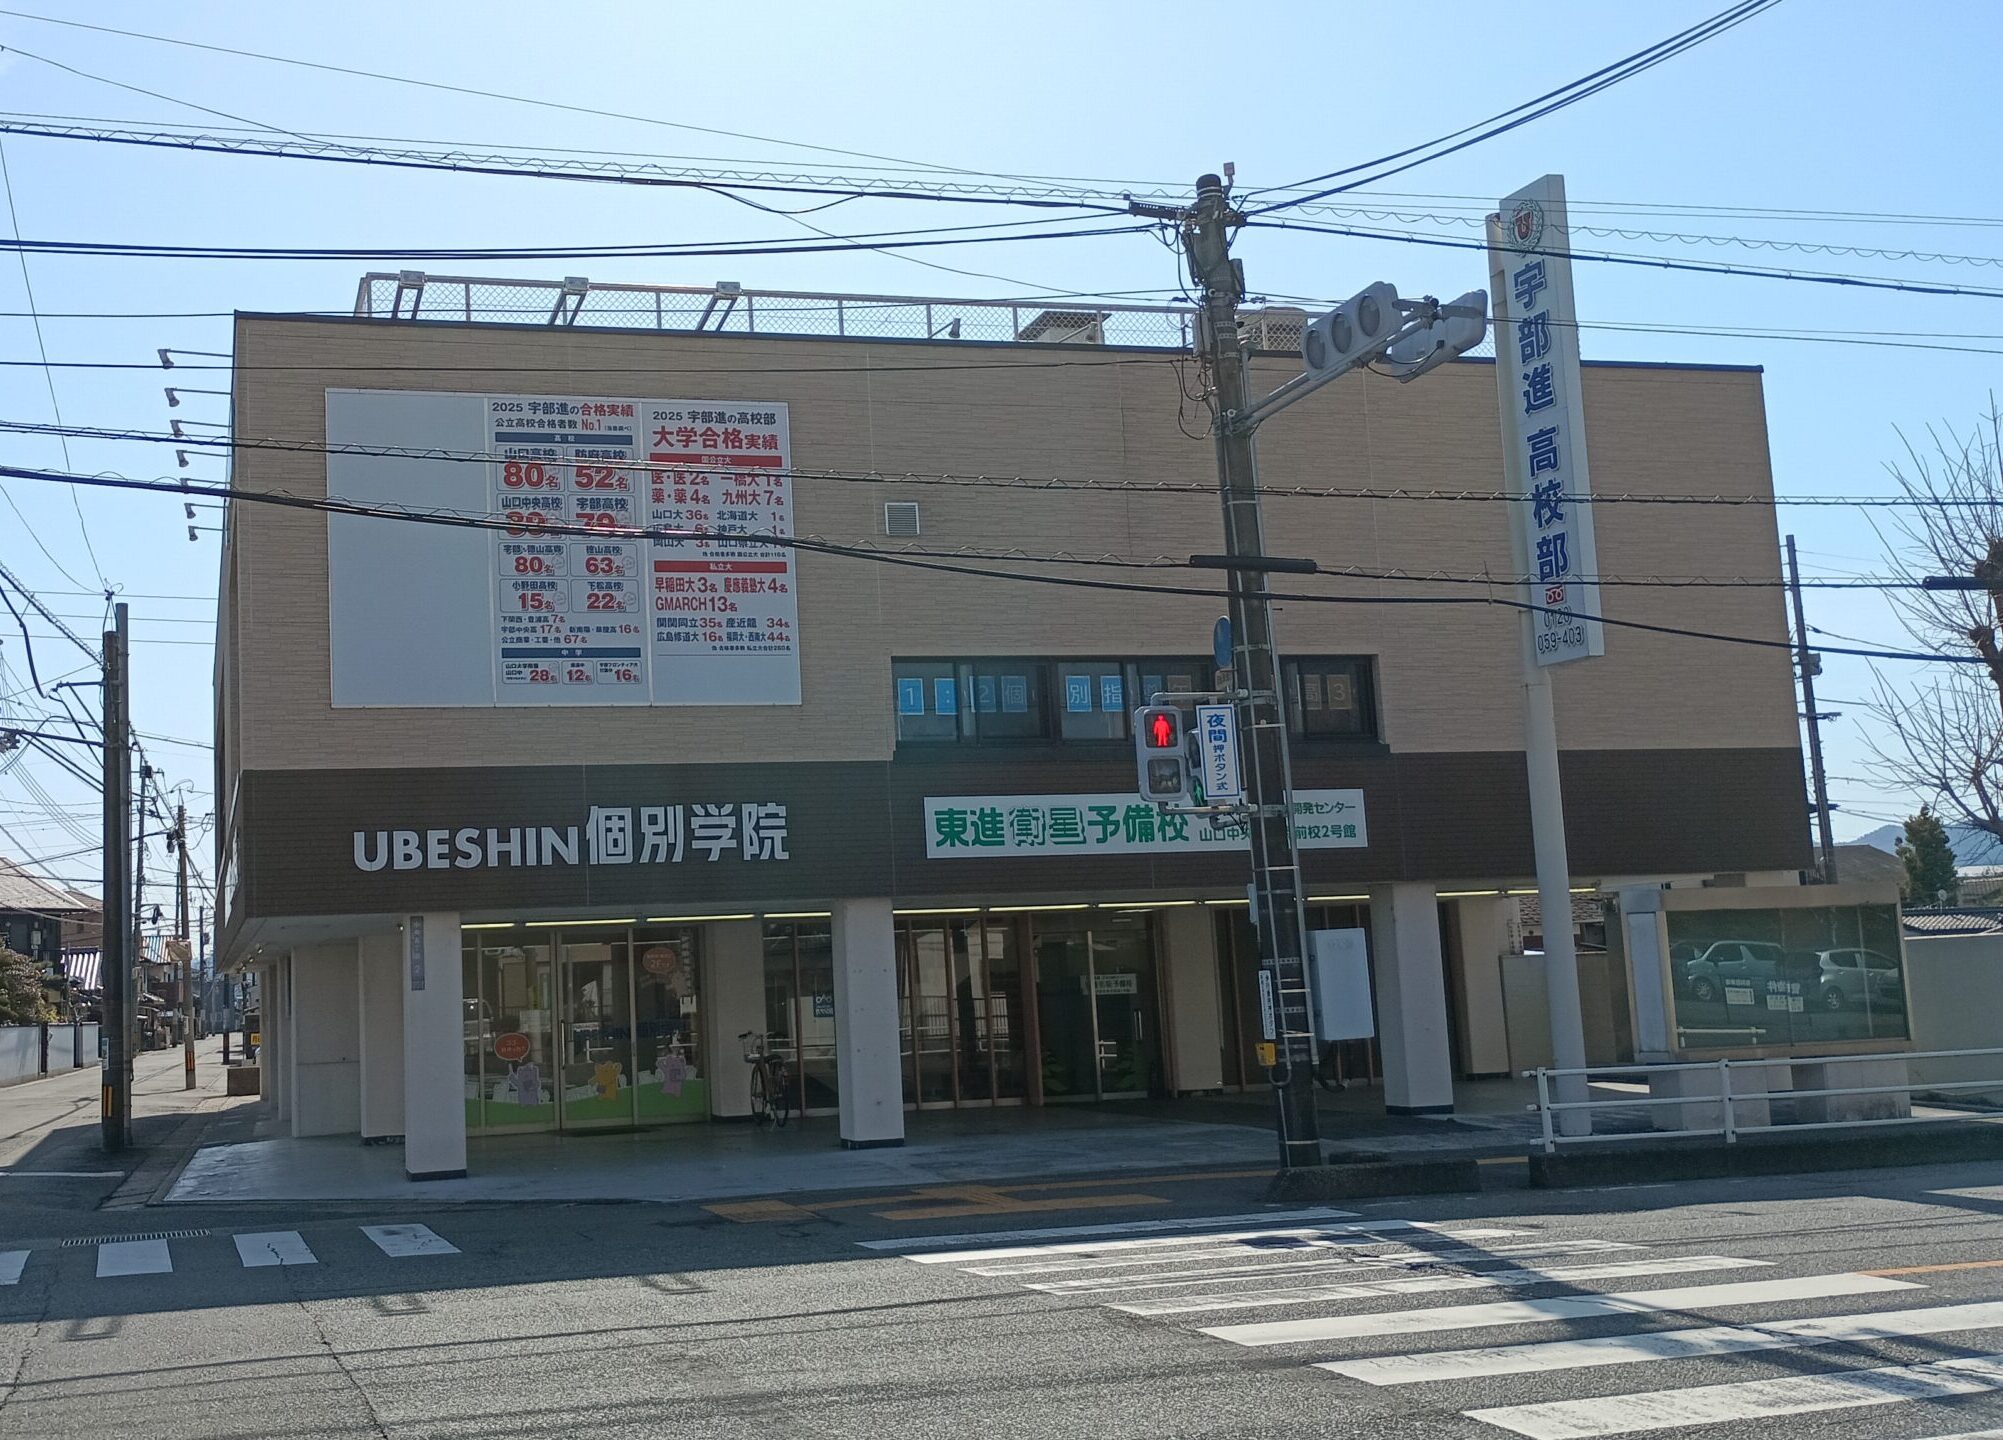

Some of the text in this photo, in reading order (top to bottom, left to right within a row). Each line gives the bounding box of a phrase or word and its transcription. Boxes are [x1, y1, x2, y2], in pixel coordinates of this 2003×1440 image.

[492, 401, 634, 417] 2025 宇部進の合格実績
[581, 419, 601, 431] No.1
[653, 410, 776, 426] 2025 宇部進の高校部
[653, 425, 778, 450] 大学合格実績
[721, 490, 761, 505] 九州大
[652, 510, 683, 520] 山口大
[716, 511, 758, 521] 北海道大
[514, 556, 554, 575] 80名
[585, 557, 625, 576] 63名
[709, 563, 733, 571] 私立大
[655, 577, 696, 593] 早稲田大
[518, 593, 554, 611] 15名
[587, 593, 625, 611] 22名
[656, 596, 738, 612] GMARCH 13名
[1537, 626, 1586, 654] 059-403
[1206, 713, 1229, 791] 夜間押ボタン式
[934, 804, 1190, 848] 東進衛星予備校
